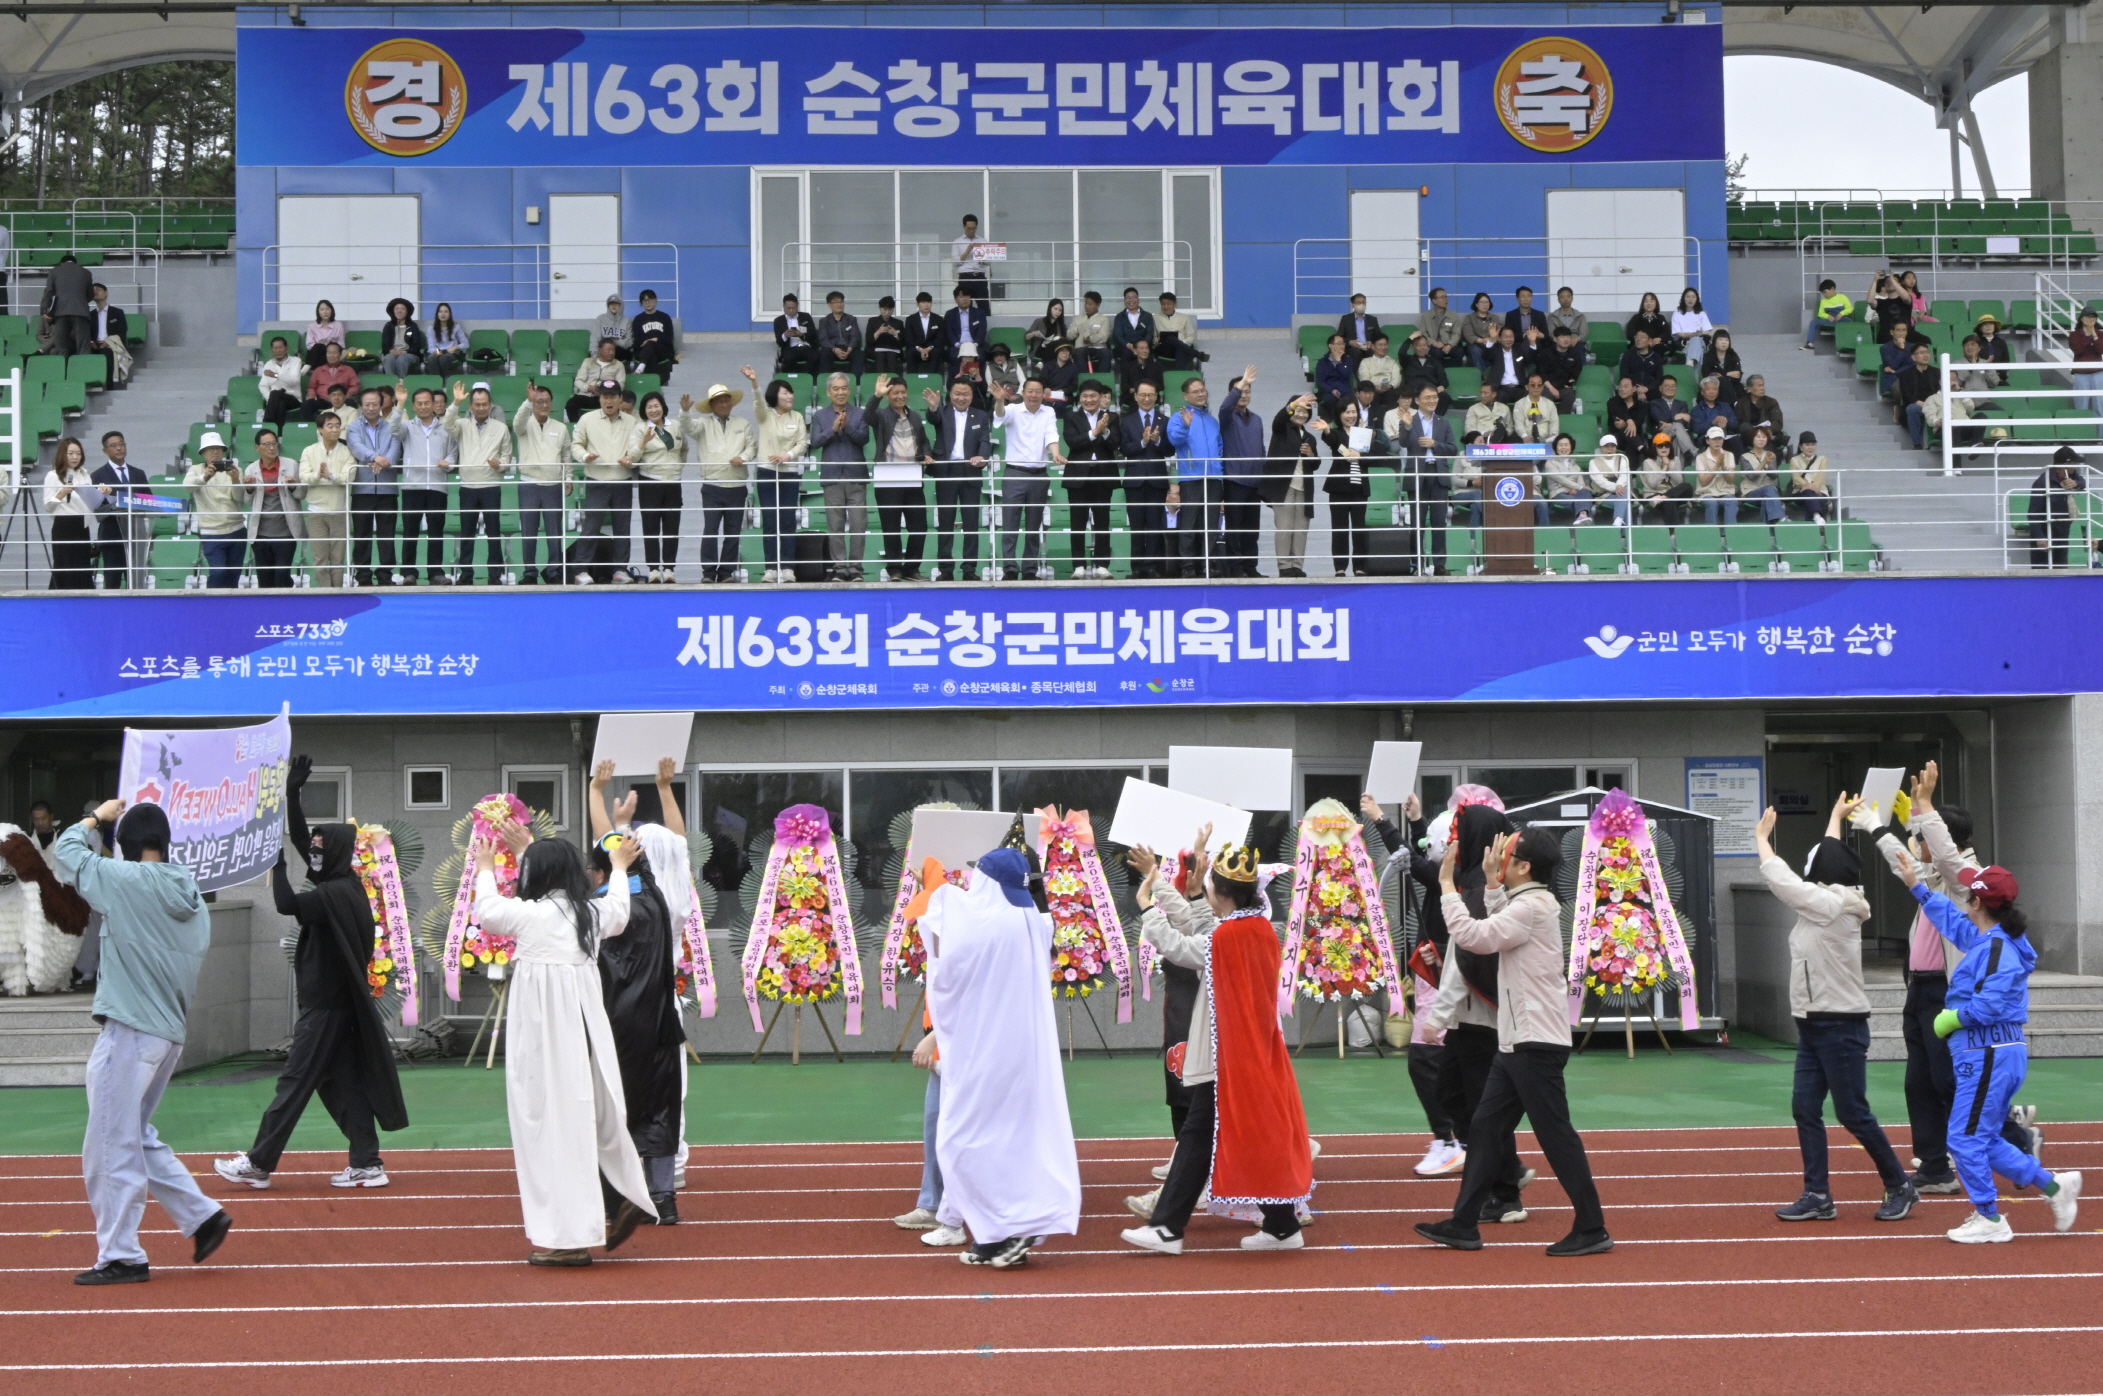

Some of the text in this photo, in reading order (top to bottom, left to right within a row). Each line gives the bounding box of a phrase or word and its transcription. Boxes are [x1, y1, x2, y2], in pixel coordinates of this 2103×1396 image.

[366, 61, 442, 139] 경
[506, 59, 1460, 138] 제63회 순창군민체육대회
[1514, 55, 1592, 133] 축
[602, 326, 626, 338] YALE
[1472, 448, 1546, 456] 제63회 순창군민체육대회
[123, 496, 142, 505] 제3회
[675, 606, 1350, 669] 제63회 순창군민체육대회
[1637, 623, 1897, 657] 군민 모두가 행복한 순창
[118, 653, 480, 679] 스포츠를 통해 군민 모두가 행복한 순창
[912, 681, 1097, 694] 주관 순창군체육회 종목단체협회
[1119, 678, 1195, 691] 후원 순창군
[768, 684, 878, 696] 주최 순창군체육회
[1778, 794, 1809, 806] 회의실
[762, 857, 784, 905] 순창군체육회
[1582, 850, 1597, 894] 순창군
[382, 870, 399, 909] 제63회
[391, 915, 412, 996] 순창군민체육대회
[754, 910, 771, 935] 스포츠
[1087, 860, 1105, 900] 2025년
[1097, 902, 1116, 934] 제63회
[1108, 936, 1131, 998] 순창군민체육대회
[1281, 846, 1313, 997] 가수 예지니
[1577, 902, 1590, 946] 이장단
[1369, 902, 1399, 996] 순창군민체육대회
